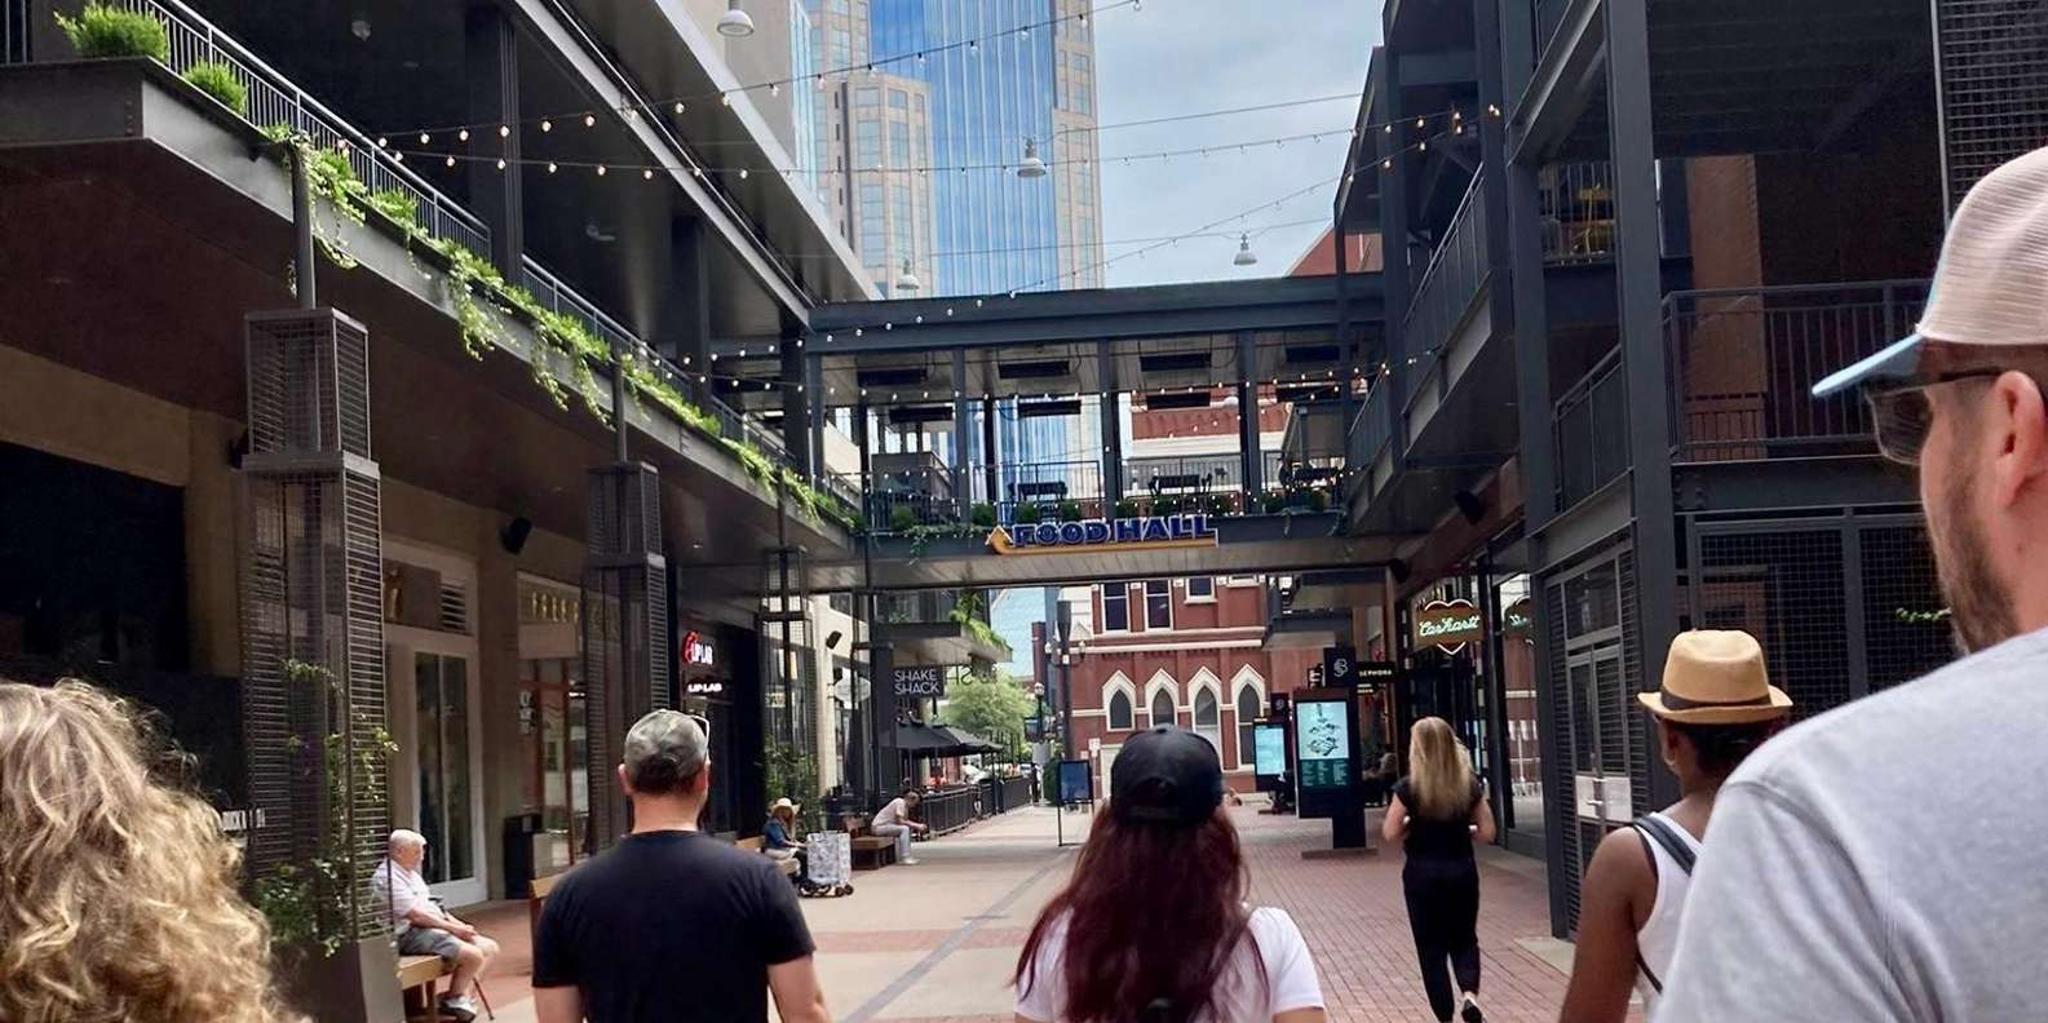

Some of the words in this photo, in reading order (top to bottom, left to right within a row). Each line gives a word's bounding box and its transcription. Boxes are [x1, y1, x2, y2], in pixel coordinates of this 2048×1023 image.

[1012, 518, 1111, 547] FOOD
[1114, 513, 1218, 542] HALL
[1419, 615, 1480, 636] Carhartt
[894, 668, 938, 683] SHAKE
[894, 681, 940, 695] SHACK
